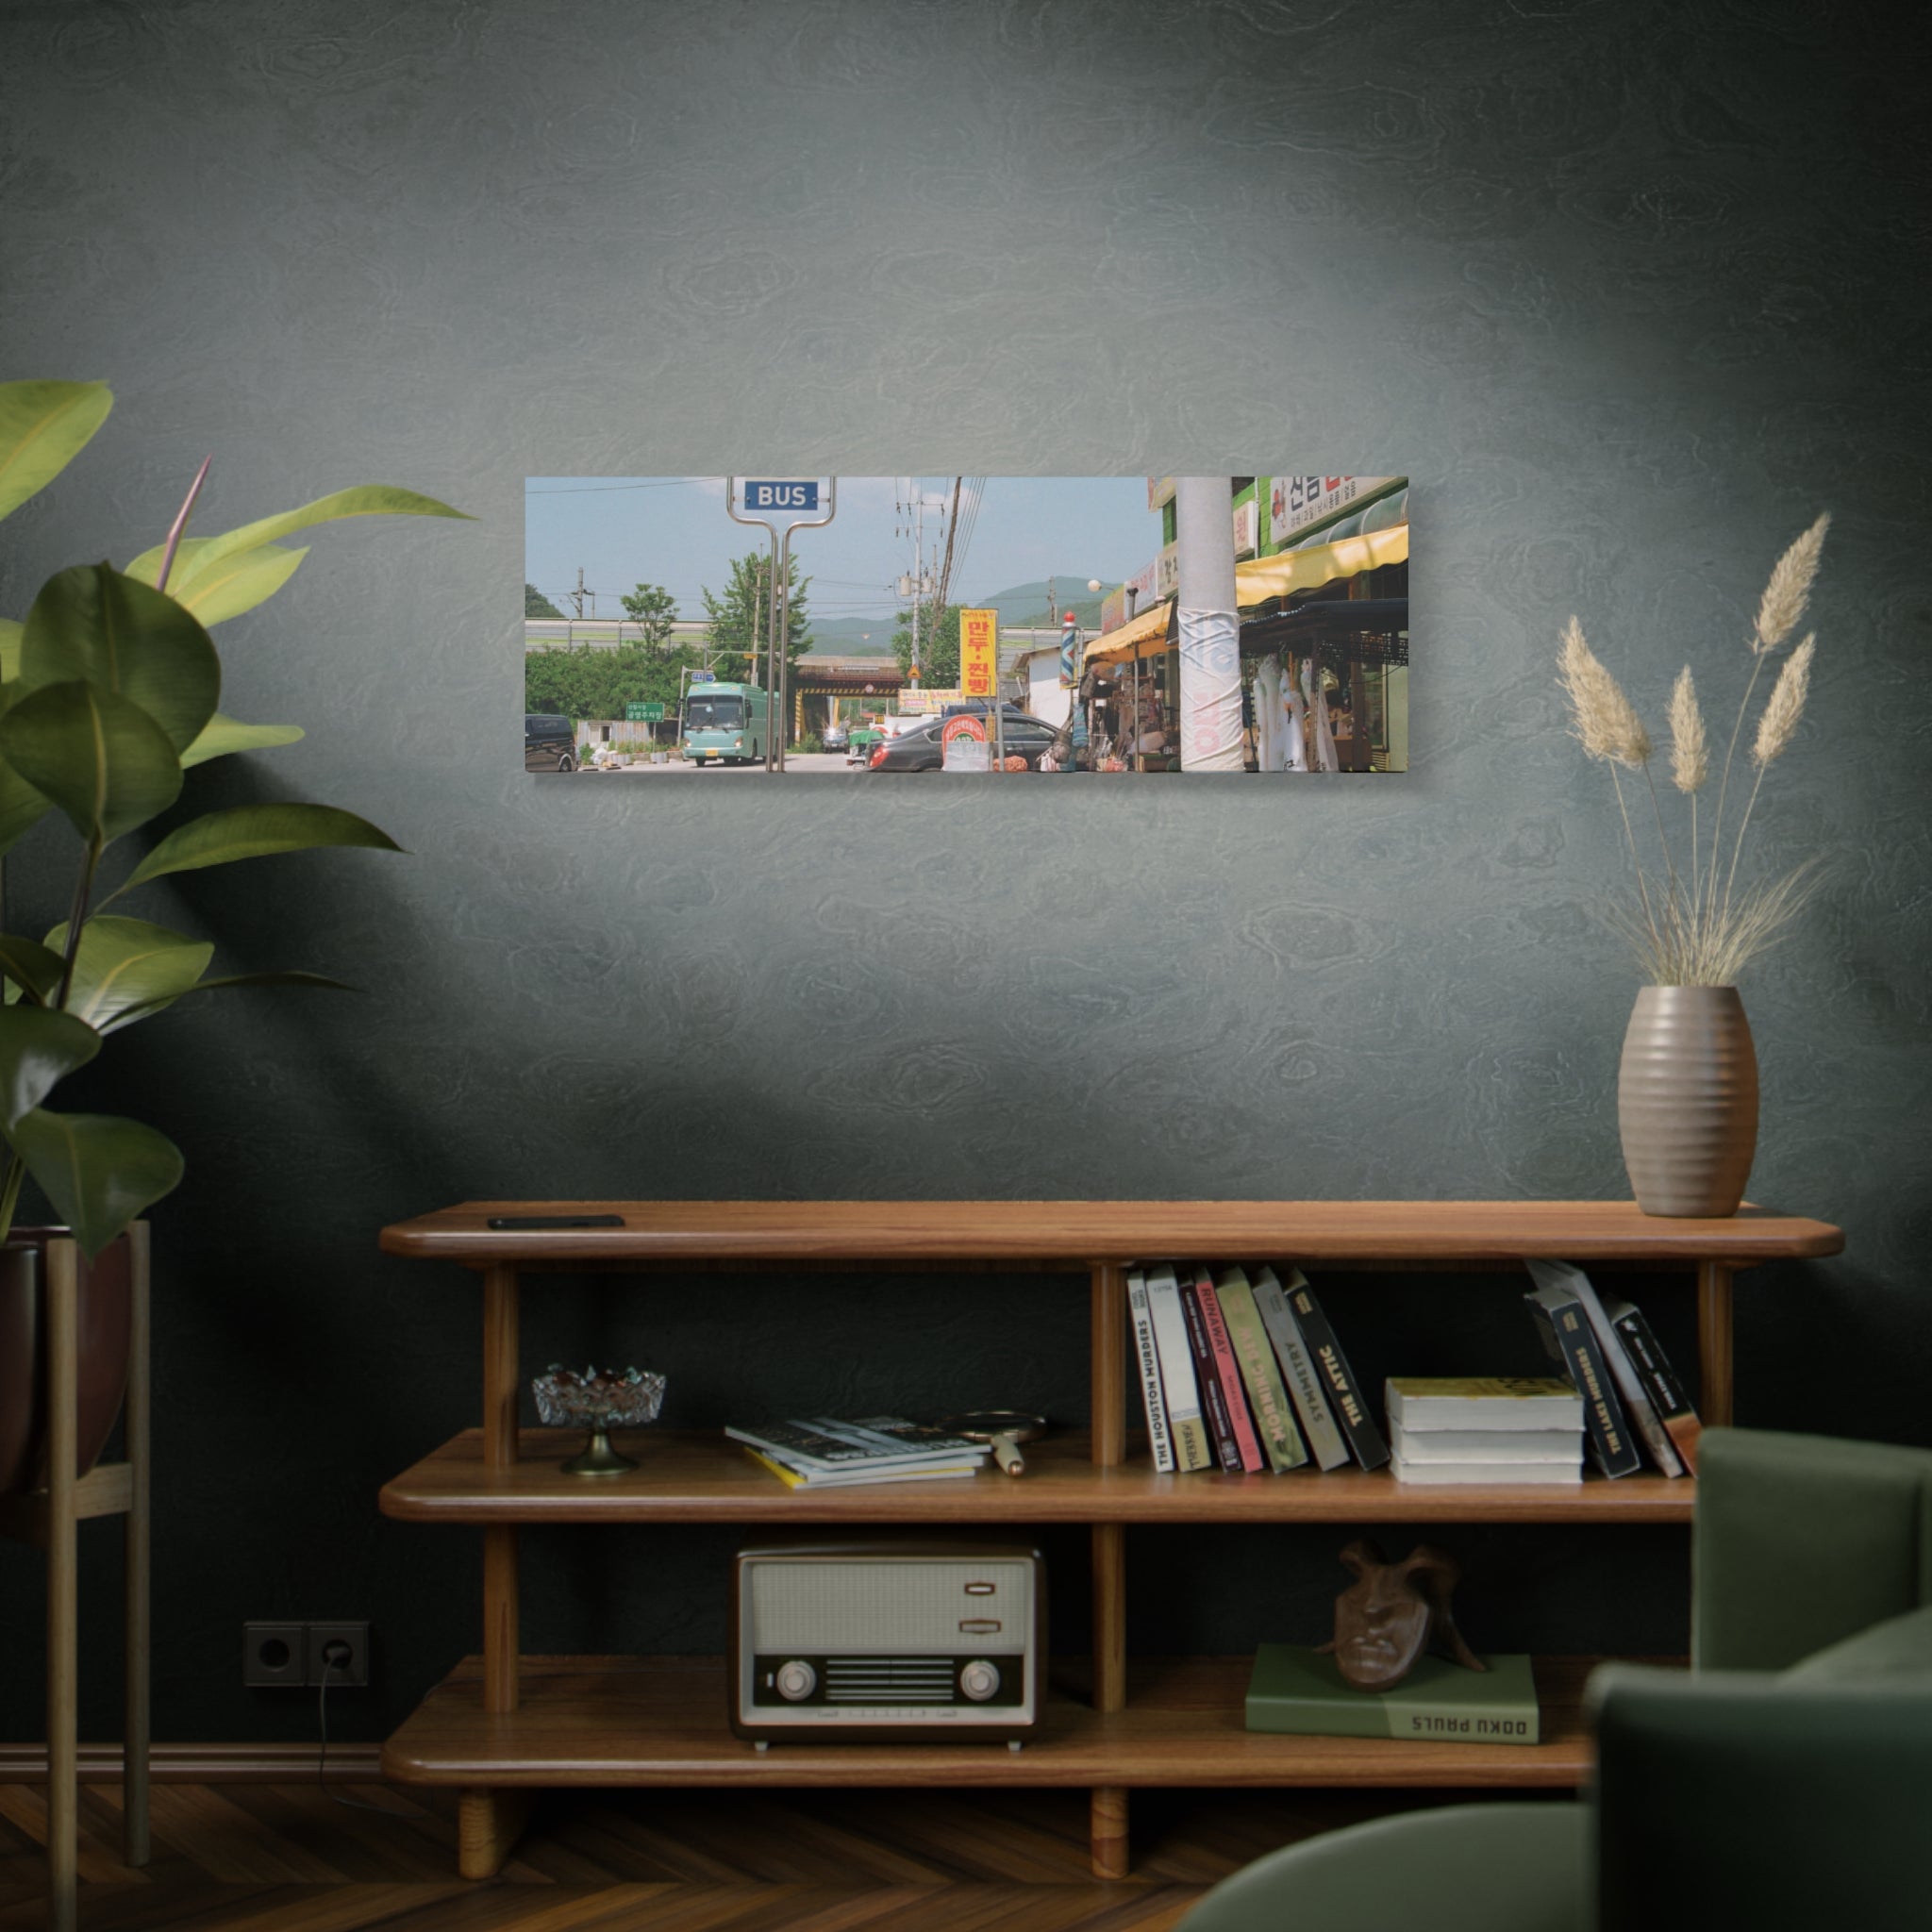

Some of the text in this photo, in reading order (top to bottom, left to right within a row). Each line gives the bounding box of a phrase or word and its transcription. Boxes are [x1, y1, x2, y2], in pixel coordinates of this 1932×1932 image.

[758, 486, 807, 506] BUS
[1202, 1288, 1229, 1355] RUNAWAY
[1138, 1320, 1169, 1468] THE HOUSTON MURDERS
[1251, 1362, 1287, 1441] MORNING
[1285, 1342, 1324, 1423] SYMMETRY
[1319, 1343, 1364, 1427] THE ATTIC
[1576, 1347, 1622, 1455] THE LAKE MURDERS
[1411, 1715, 1527, 1736] DOKU PAULS
